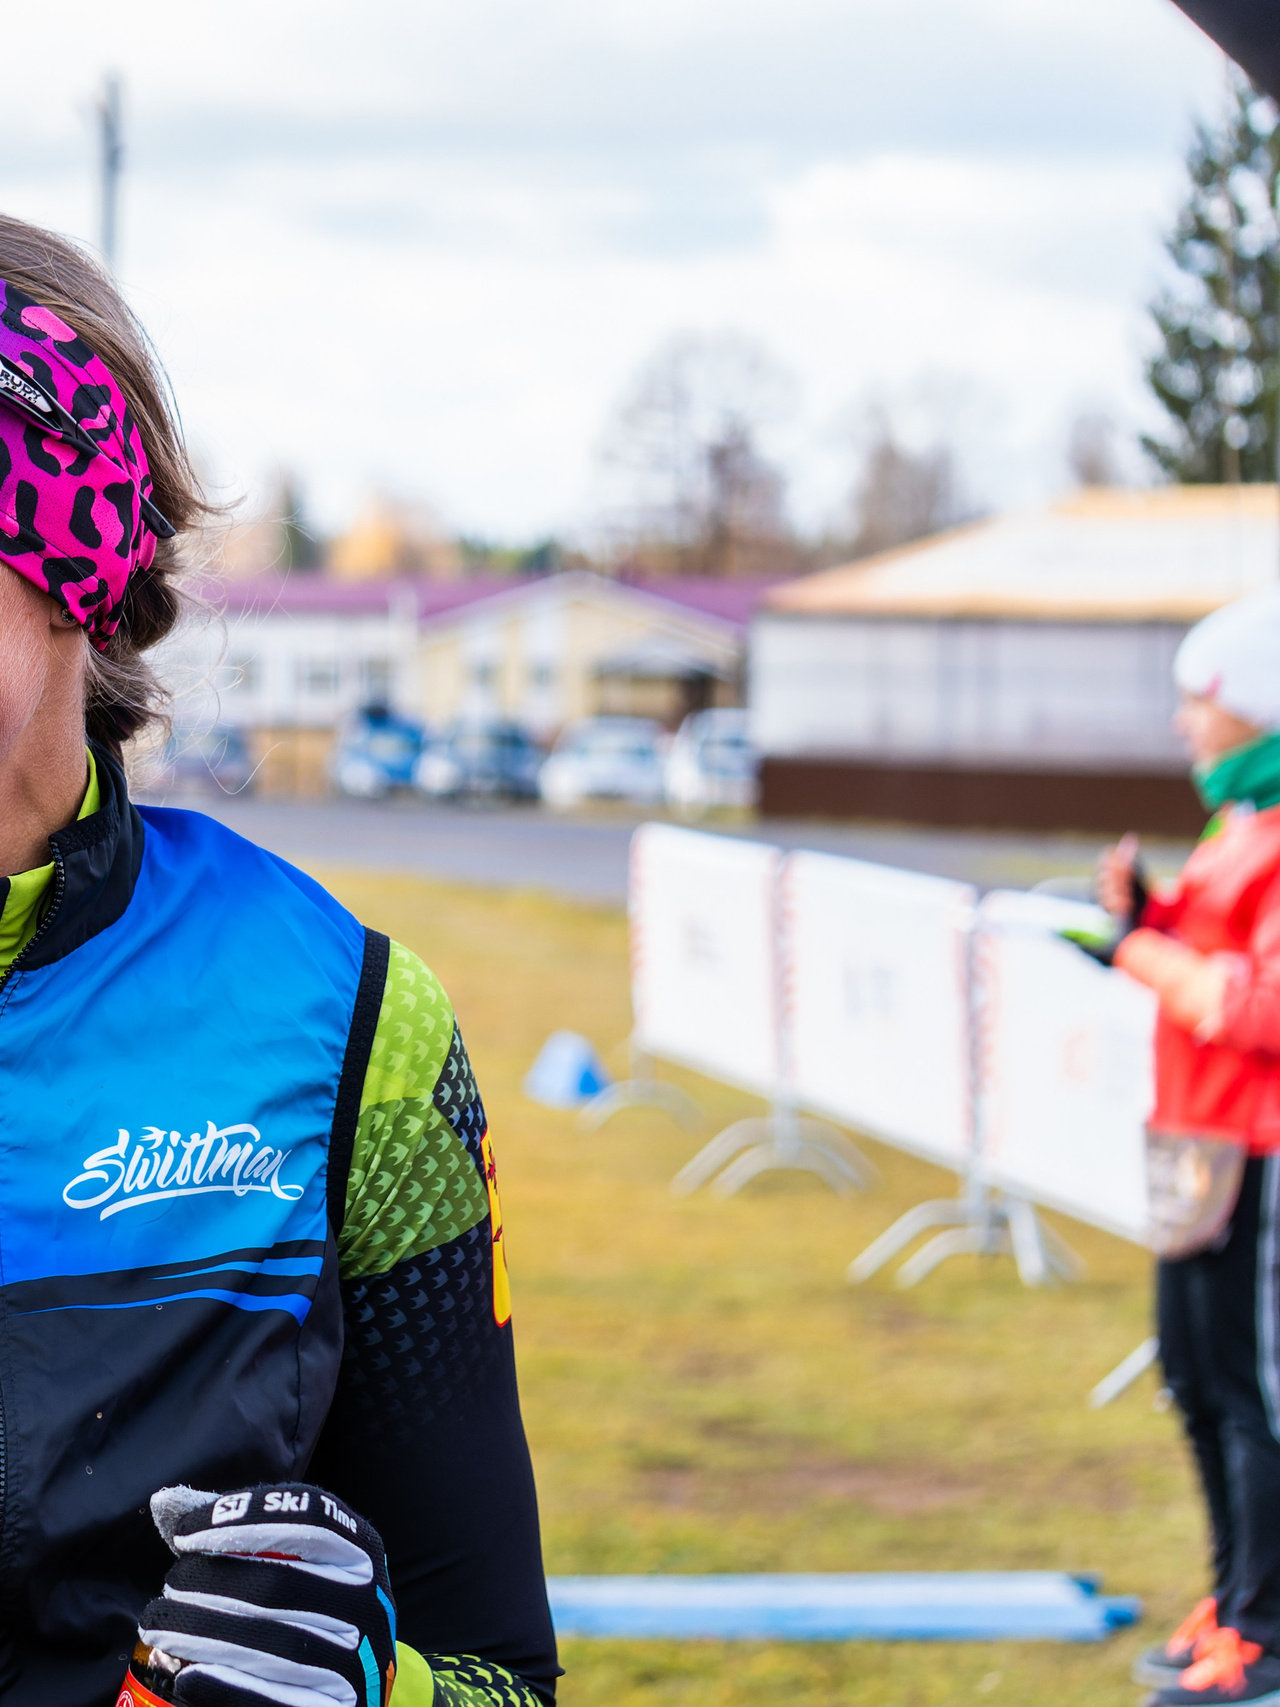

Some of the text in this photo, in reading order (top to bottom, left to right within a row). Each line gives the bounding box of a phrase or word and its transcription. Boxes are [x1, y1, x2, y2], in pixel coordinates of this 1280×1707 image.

[0, 369, 41, 400] RUDY
[263, 1491, 311, 1513] Ski
[320, 1495, 358, 1534] Time
